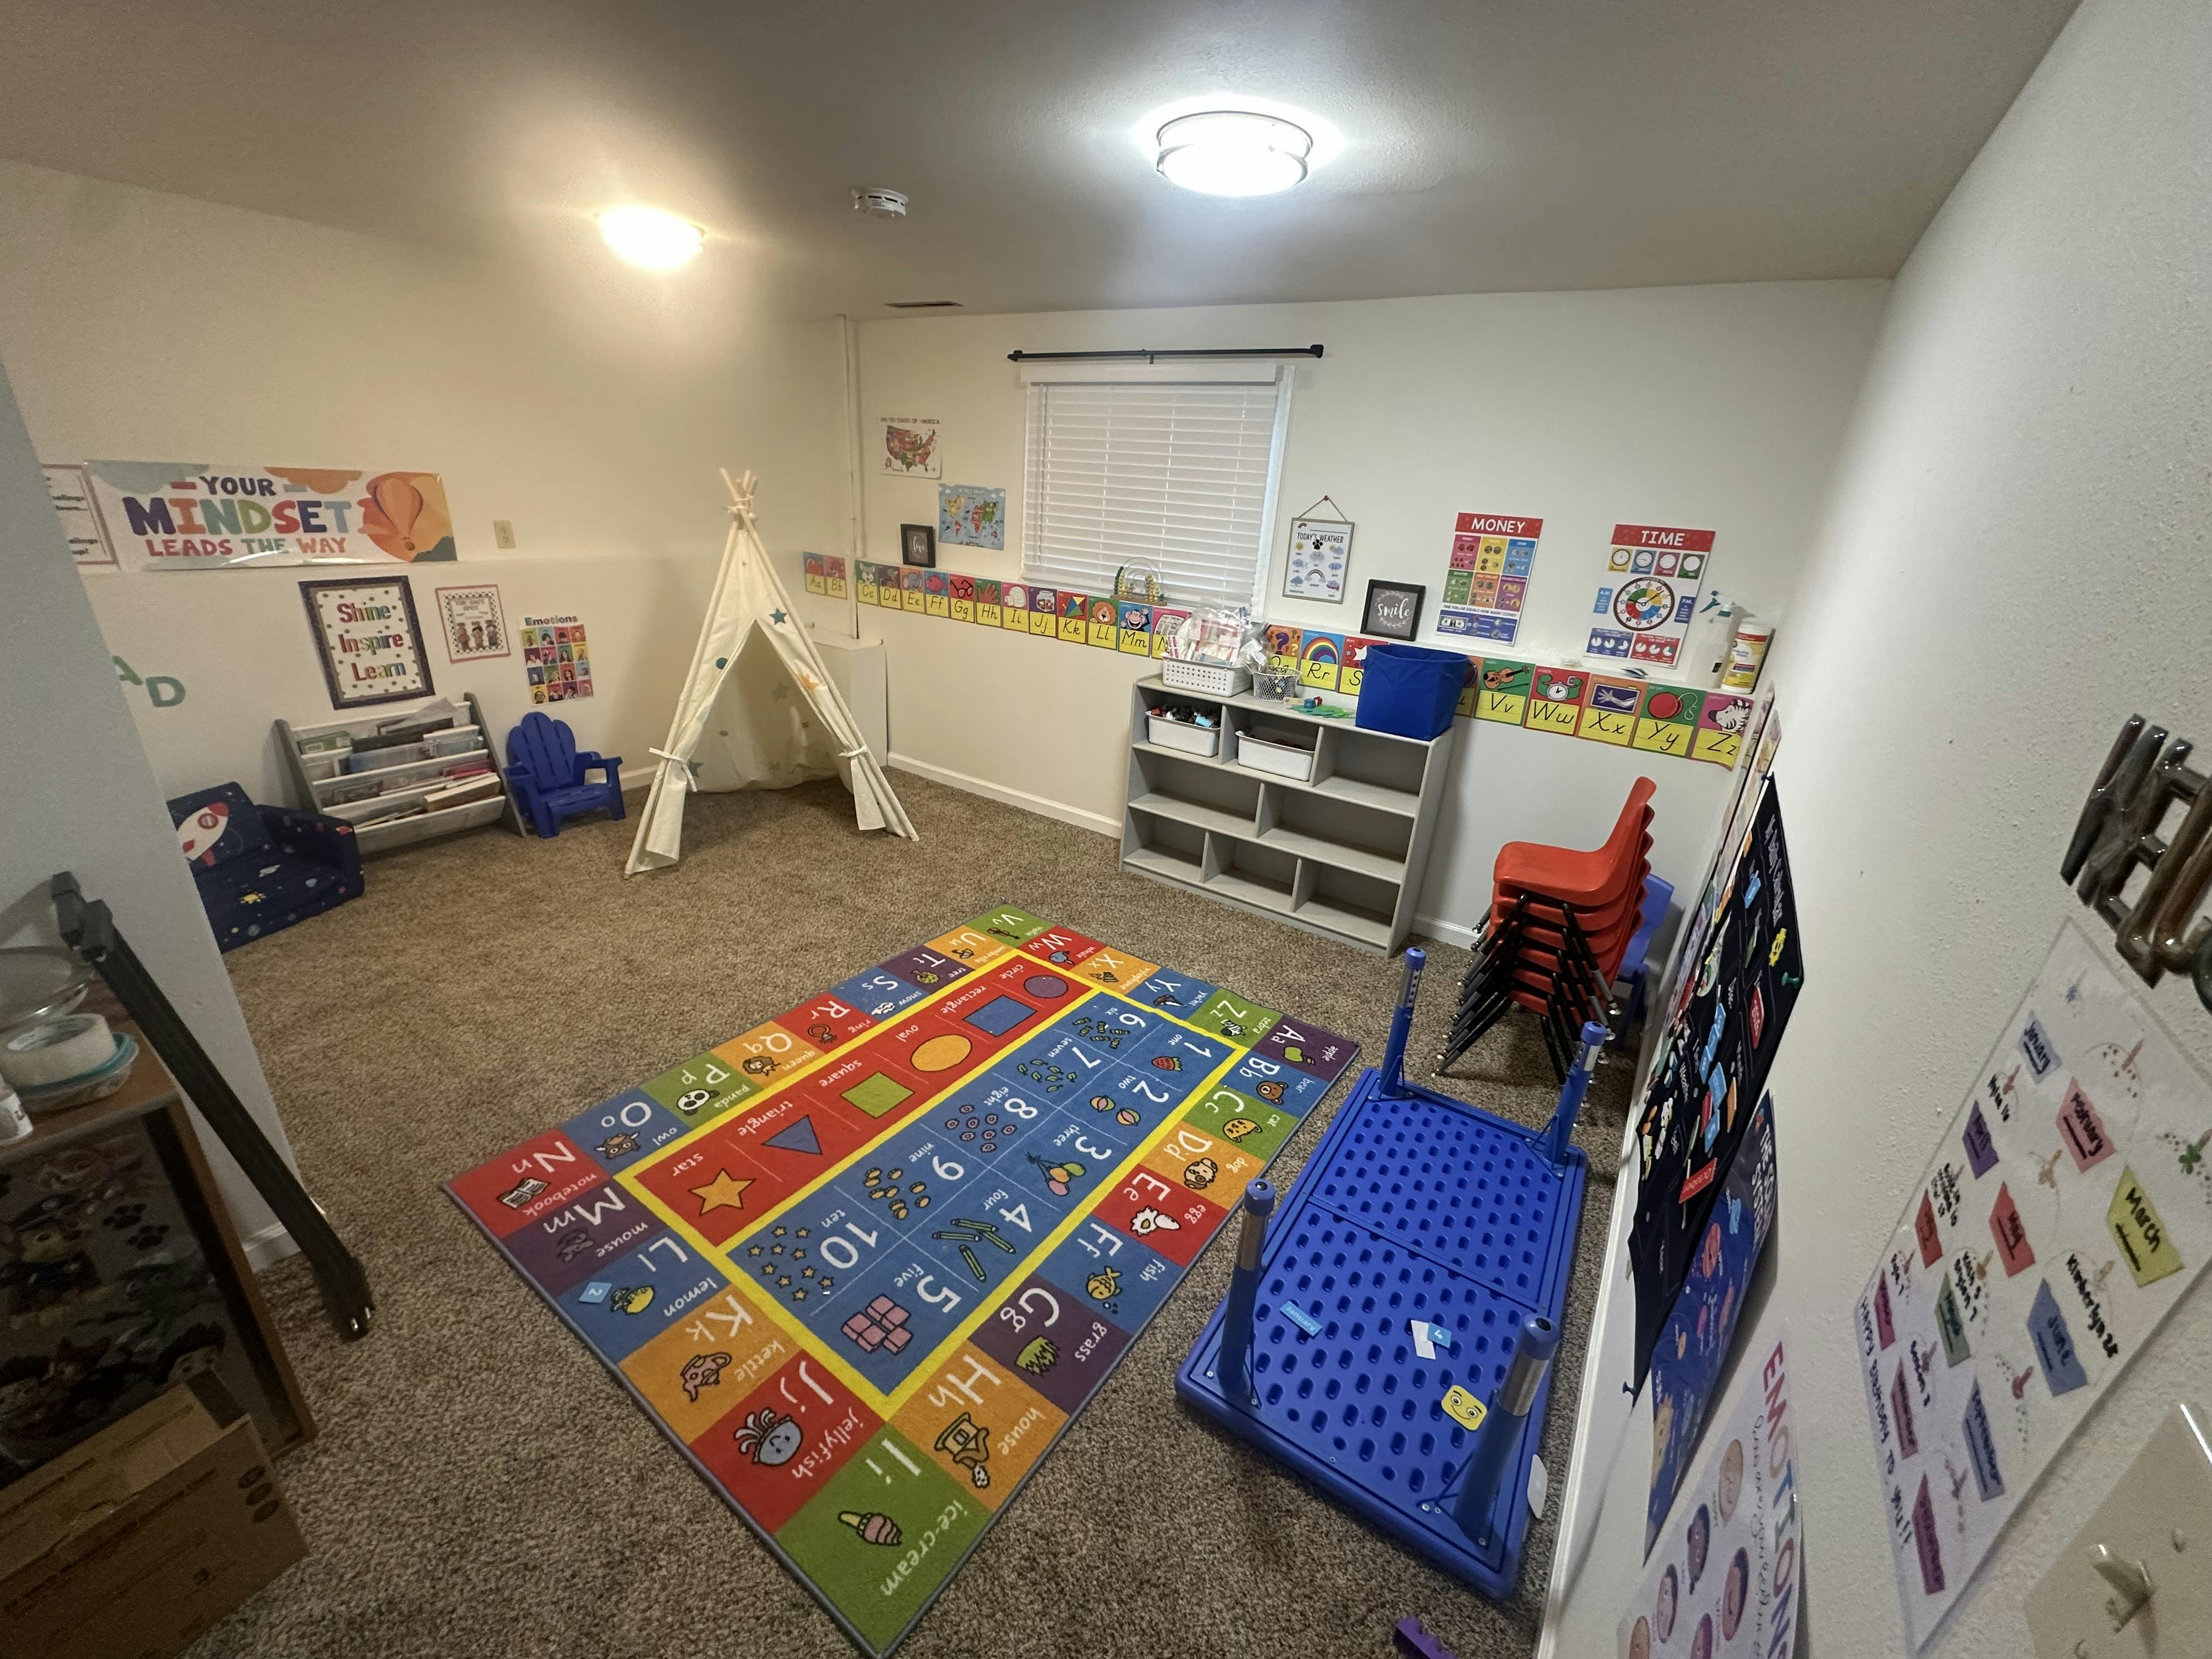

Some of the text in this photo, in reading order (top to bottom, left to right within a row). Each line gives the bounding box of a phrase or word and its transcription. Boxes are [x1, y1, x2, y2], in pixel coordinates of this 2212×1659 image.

[199, 476, 276, 496] YOUR
[122, 496, 352, 536] MINDSET
[1471, 518, 1526, 534] MONEY
[145, 537, 346, 557] LEADS THE WAY
[1297, 532, 1344, 543] TODAY'S WEATHER
[1641, 530, 1685, 546] TIME
[810, 577, 822, 589] Aa
[832, 579, 842, 591] Bb
[862, 585, 874, 599] Cc
[883, 590, 898, 602] Dd
[908, 594, 919, 606] Ee
[930, 597, 943, 611] Ff
[337, 602, 391, 623] Shine
[955, 600, 969, 619] Gg
[981, 604, 997, 619] Hh
[1012, 609, 1022, 624] Ii
[1378, 598, 1412, 619] smile
[524, 615, 578, 626] Emotions
[1035, 613, 1048, 634] Jj
[1063, 619, 1080, 635] Kk
[338, 630, 404, 655] Inspire
[1097, 625, 1109, 641] Ll
[1122, 631, 1147, 648] Mm
[350, 660, 406, 682] Learn
[1307, 662, 1329, 680] Rr
[1491, 693, 1514, 713] Vv
[1533, 701, 1574, 724] Ww
[1588, 712, 1625, 734] Xx
[1647, 721, 1679, 751] Yy
[1707, 732, 1737, 755] Zz
[992, 913, 1024, 926] Vv
[949, 932, 986, 947] Uu
[1029, 933, 1072, 951] Ww
[912, 953, 946, 967] Tt
[974, 945, 1007, 963] umbrella
[1075, 946, 1096, 959] whale
[1087, 953, 1124, 968] Xx
[949, 967, 966, 979] tree
[999, 964, 1024, 979] circle
[1120, 967, 1150, 989] xylophone
[862, 975, 899, 991] Ss
[1152, 978, 1181, 993] Yy
[899, 991, 922, 1006] snow
[940, 985, 986, 1014] rectangle
[1190, 991, 1207, 1007] yacht
[1210, 999, 1247, 1019] Zz
[811, 1000, 850, 1020] Rr
[1104, 1006, 1119, 1016] six
[849, 1019, 871, 1034] ring
[1120, 1013, 1146, 1029] 6
[1252, 1017, 1272, 1034] zebra
[750, 1032, 792, 1054] Qq
[896, 1024, 919, 1043] oval
[1168, 1034, 1182, 1047] one
[1271, 1024, 1306, 1045] Aa
[1047, 1036, 1073, 1058] seven
[1184, 1041, 1212, 1058] 1
[1321, 1045, 1339, 1063] apple
[2023, 1020, 2051, 1070] January
[782, 1050, 816, 1071] queen
[1071, 1046, 1102, 1069] 7
[1239, 1057, 1282, 1079] Bb
[681, 1063, 731, 1085] Pp
[819, 1059, 863, 1088] square
[1119, 1075, 1136, 1090] two
[1132, 1080, 1170, 1103] 2
[1296, 1077, 1314, 1094] bear
[713, 1084, 751, 1110] panda
[983, 1086, 1009, 1107] eight
[1205, 1091, 1244, 1114] Cc
[601, 1101, 652, 1128] Oo
[737, 1100, 793, 1137] triangle
[1003, 1097, 1038, 1120] 8
[1267, 1114, 1280, 1127] cat
[652, 1127, 678, 1146] owl
[1053, 1124, 1080, 1147] three
[1164, 1130, 1213, 1161] Dd
[511, 1141, 576, 1174] Nn
[908, 1142, 935, 1164] nine
[1075, 1136, 1112, 1160] 3
[1760, 1123, 1773, 1171] THE
[672, 1153, 704, 1177] star
[932, 1155, 964, 1180] 9
[1225, 1156, 1248, 1175] dog
[523, 1172, 597, 1217] notebook
[1123, 1172, 1171, 1201] Ee
[543, 1187, 627, 1234] Mm
[983, 1189, 1009, 1211] four
[821, 1209, 845, 1228] ten
[998, 1203, 1032, 1232] 4
[1184, 1204, 1206, 1225] egg
[2125, 1186, 2164, 1253] March
[595, 1221, 649, 1258] mouse
[820, 1221, 878, 1269] 10
[1077, 1223, 1124, 1258] Ff
[637, 1236, 689, 1272] Ll
[894, 1263, 924, 1288] five
[1139, 1258, 1165, 1282] fish
[589, 1288, 603, 1297] 2
[663, 1277, 718, 1317] lemon
[917, 1275, 962, 1313] 5
[685, 1295, 754, 1342] Kk
[1000, 1288, 1059, 1333] Gg
[1285, 1305, 1317, 1331] January
[1074, 1321, 1108, 1362] grass
[1434, 1329, 1443, 1339] 4
[736, 1339, 785, 1383] kettle
[780, 1360, 834, 1413] Jj
[928, 1355, 1001, 1408] Hh
[997, 1406, 1046, 1457] house
[791, 1407, 864, 1480] jellyfish
[865, 1437, 921, 1485] Ii
[880, 1499, 969, 1597] ice-cream
